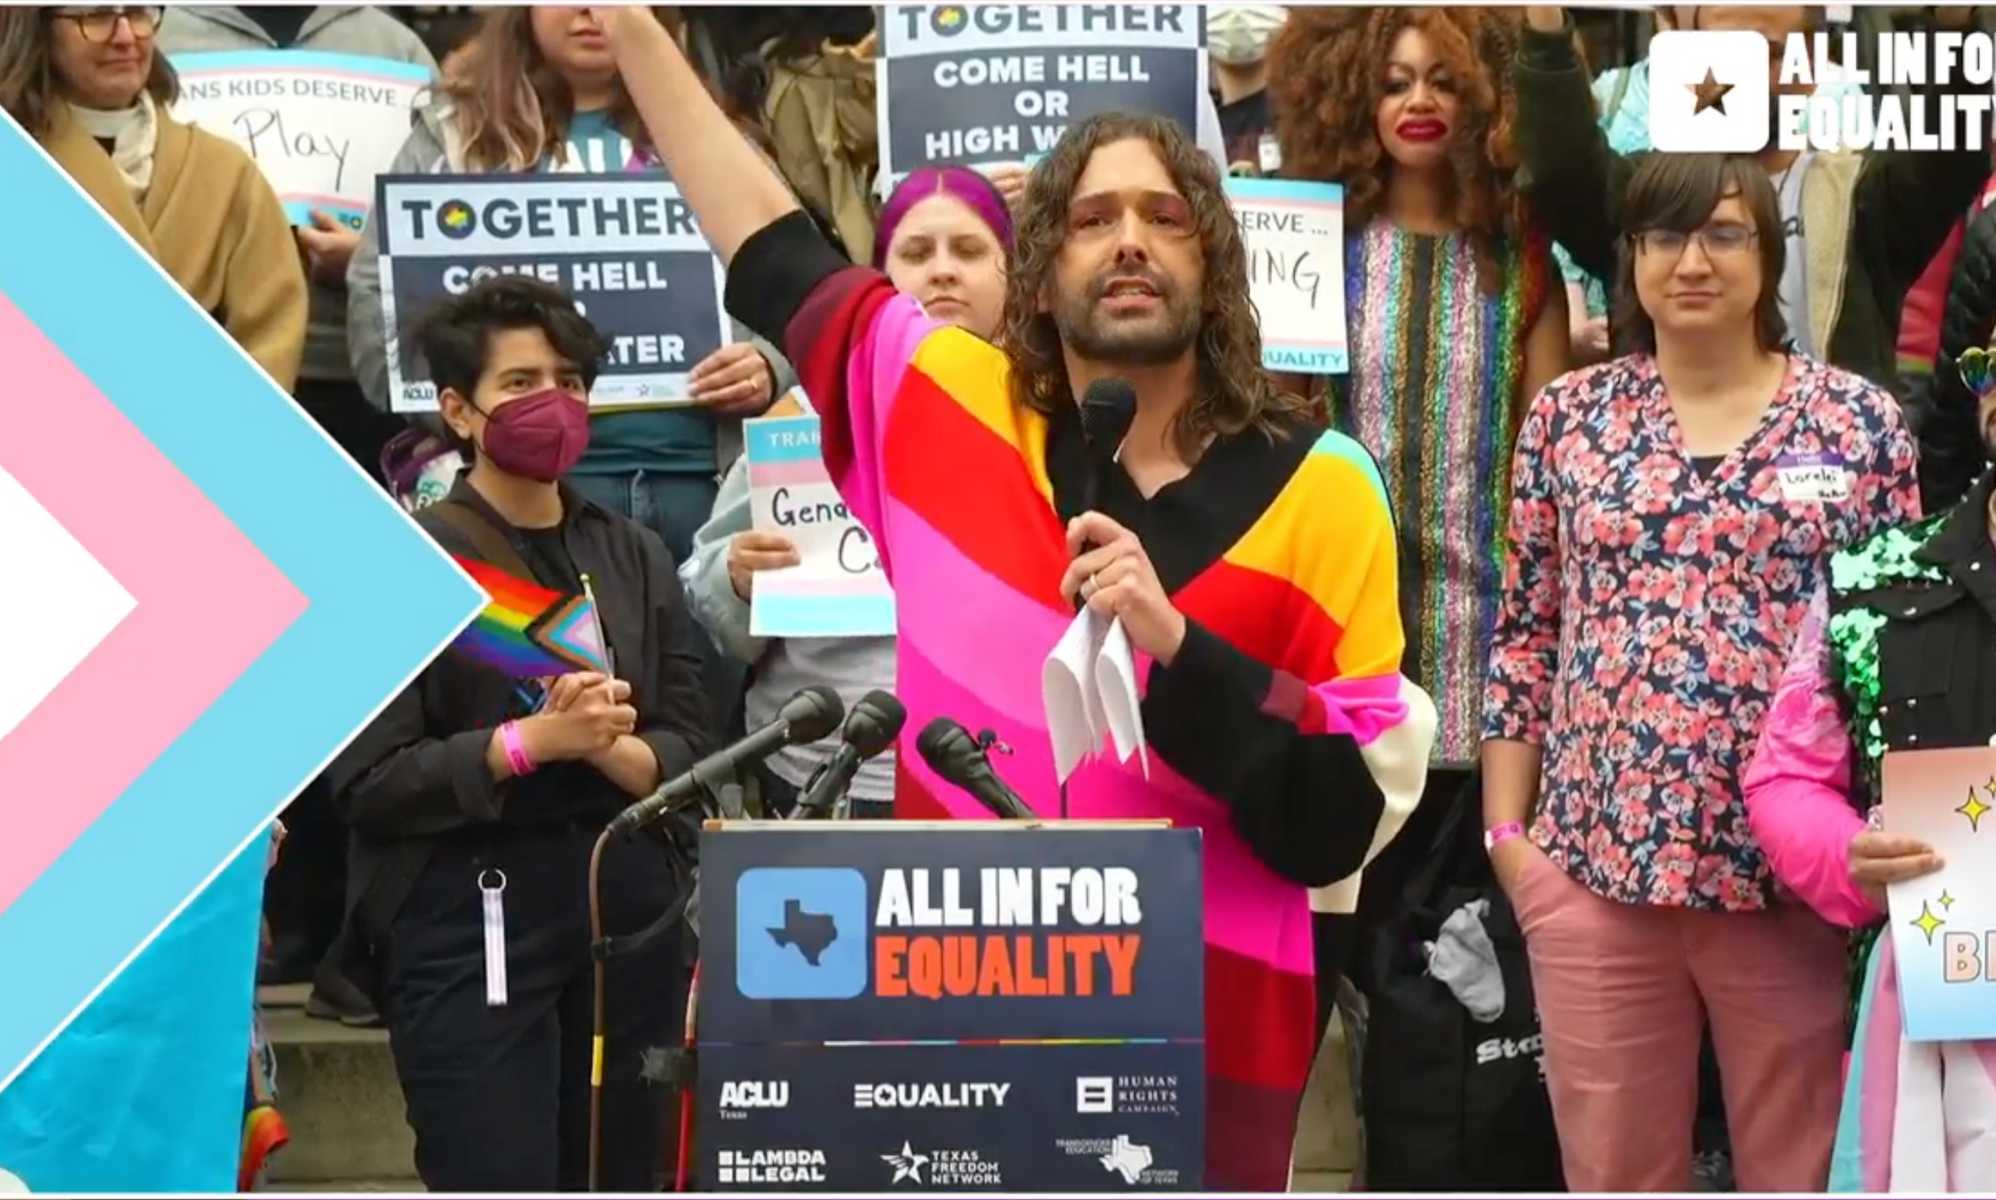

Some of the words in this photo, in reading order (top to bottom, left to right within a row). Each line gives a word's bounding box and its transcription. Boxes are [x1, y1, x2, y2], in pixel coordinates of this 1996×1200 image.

[898, 5, 1183, 40] TOGETHER
[934, 56, 1045, 88] COME
[1057, 55, 1149, 82] HELL
[229, 79, 286, 97] KIDS
[293, 79, 398, 107] DESERVE
[1014, 90, 1069, 117] OR
[232, 107, 350, 192] Play
[925, 125, 1020, 160] HIGH
[402, 197, 695, 240] TOGETHER
[1236, 209, 1304, 234] ERVE
[572, 261, 668, 292] HELL
[1263, 350, 1343, 367] UALITY
[875, 867, 974, 926] ALL
[980, 867, 1033, 926] IN
[1041, 867, 1142, 926] FOR
[875, 934, 1141, 1000] EQUALITY
[719, 1080, 790, 1108] ACLU
[854, 1082, 1011, 1108] EQUALITY
[1118, 1076, 1178, 1088] HUMAN
[1118, 1090, 1178, 1102] RIGHTS
[735, 1149, 827, 1166] LAMBDA
[931, 1150, 979, 1162] TEXAS
[931, 1162, 999, 1173] FREEDOM
[750, 1166, 826, 1182] LEGAL
[931, 1173, 1002, 1185] NETWORK
